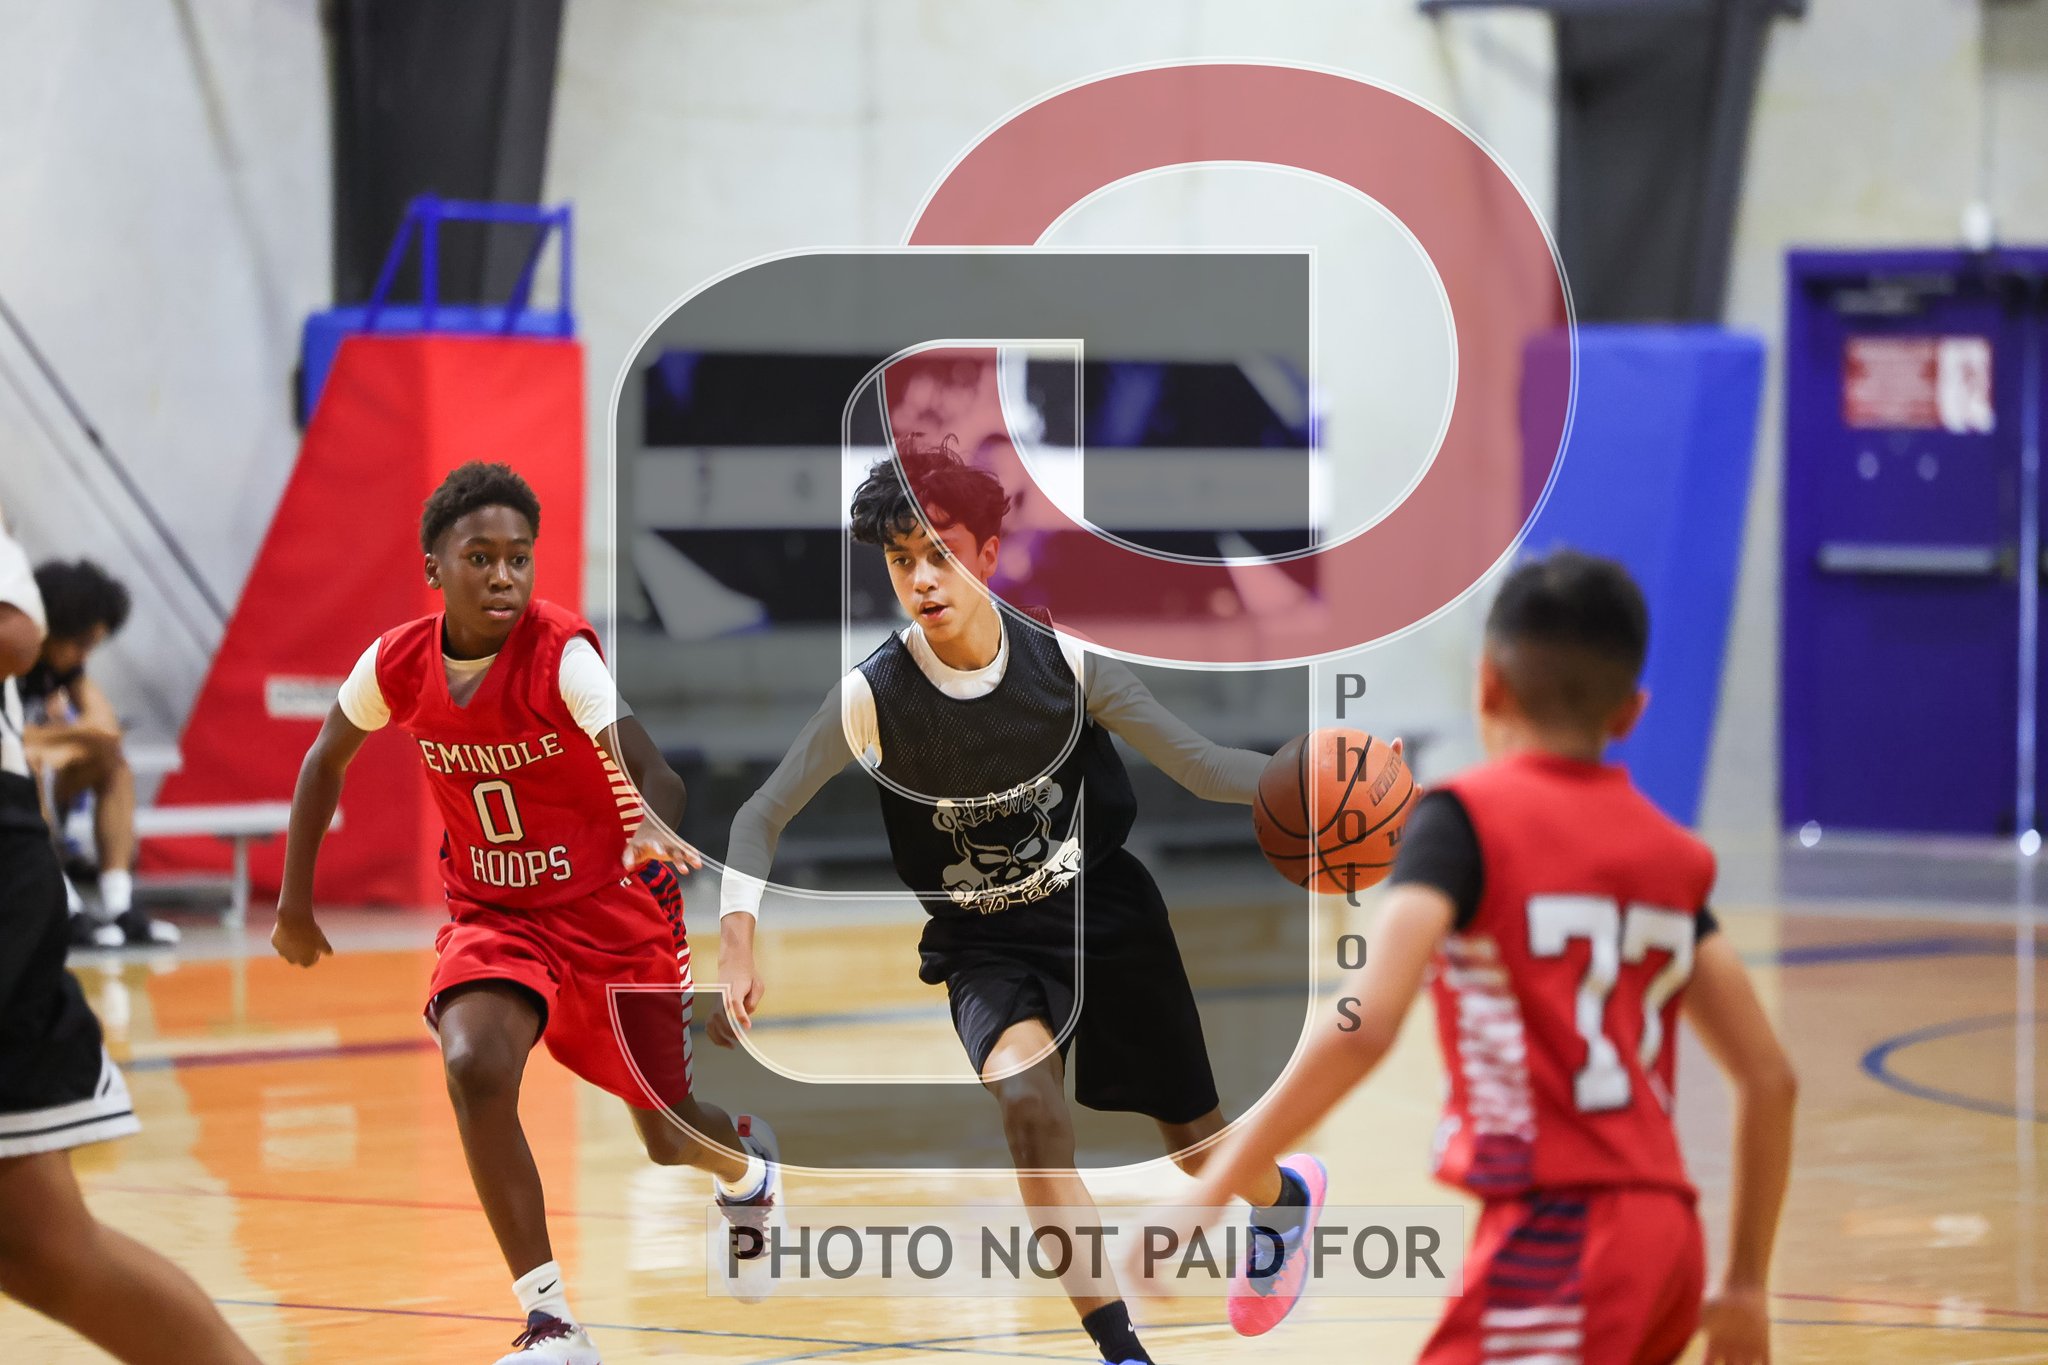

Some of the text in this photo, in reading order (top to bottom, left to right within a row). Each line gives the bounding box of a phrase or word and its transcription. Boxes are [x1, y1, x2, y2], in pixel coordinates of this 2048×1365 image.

[410, 731, 564, 775] EMINOLE
[472, 777, 525, 845] 0
[468, 844, 573, 889] HOOPS
[1526, 893, 1696, 1114] 77
